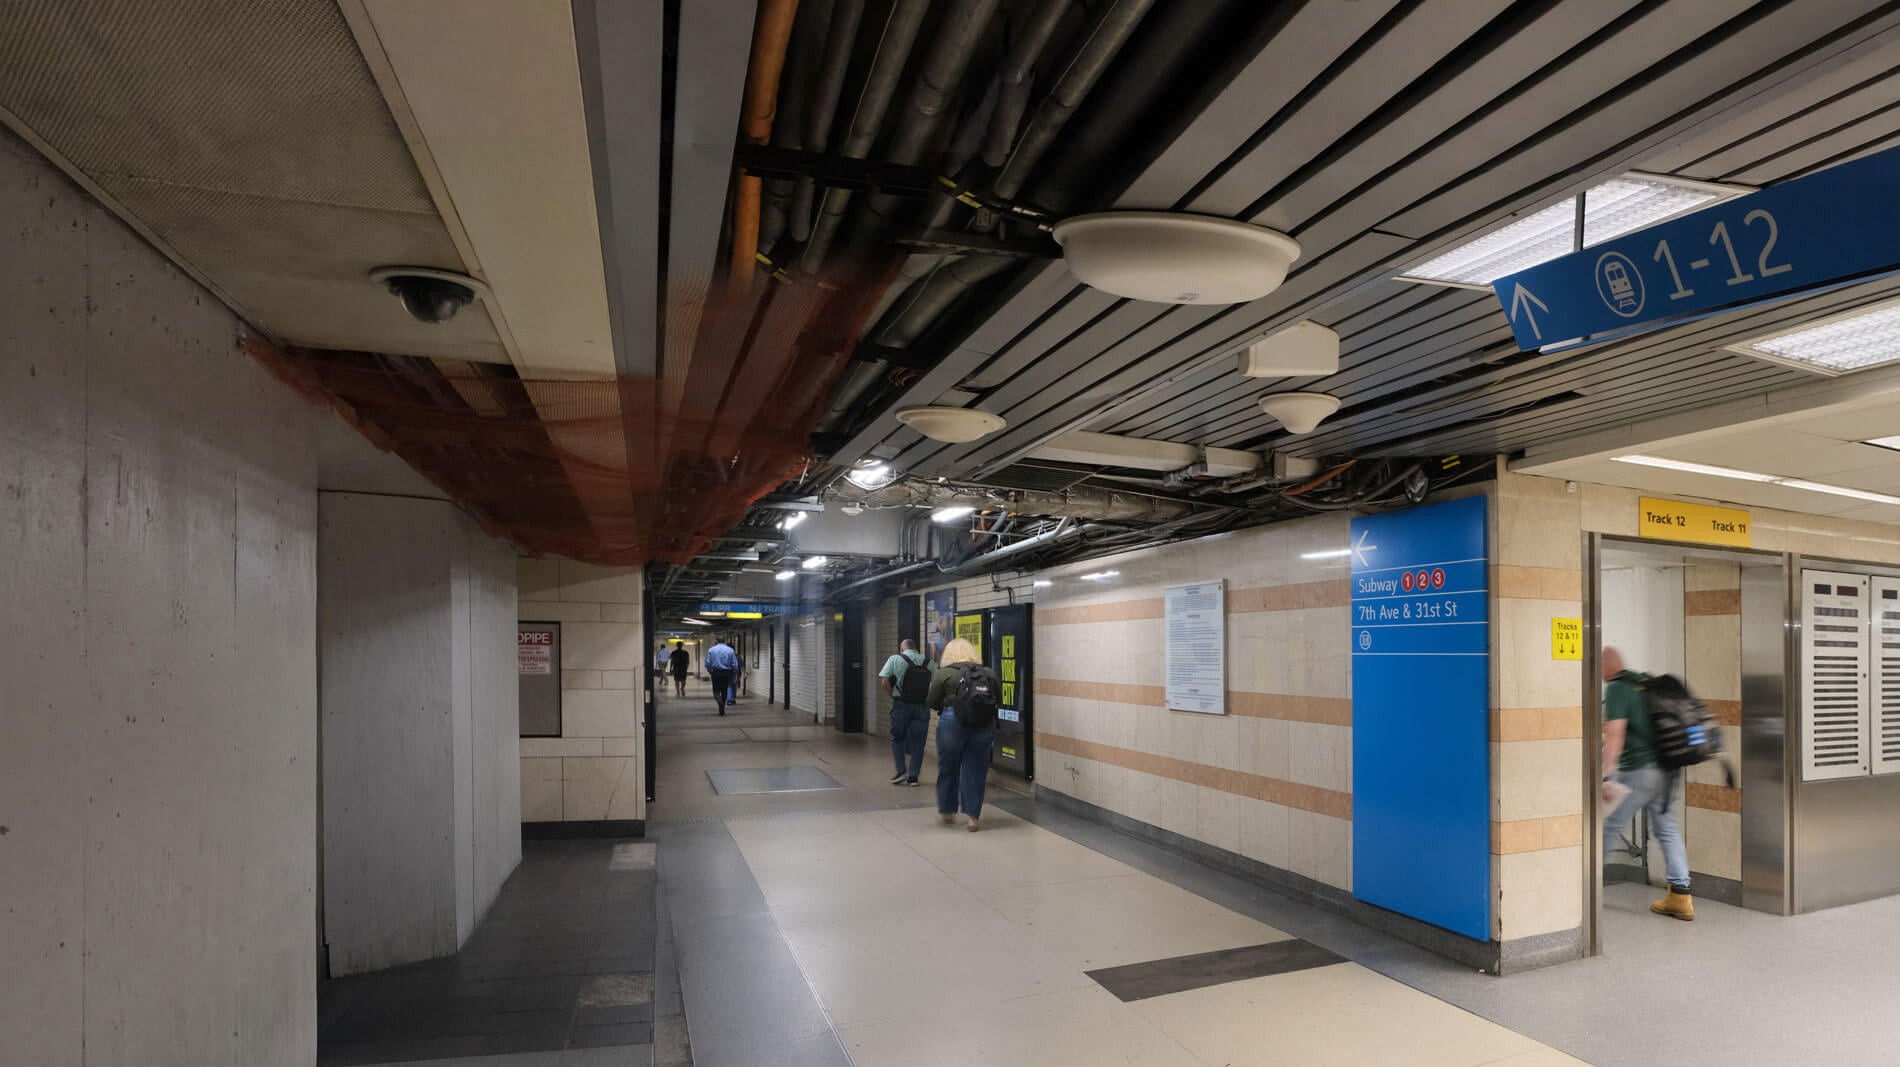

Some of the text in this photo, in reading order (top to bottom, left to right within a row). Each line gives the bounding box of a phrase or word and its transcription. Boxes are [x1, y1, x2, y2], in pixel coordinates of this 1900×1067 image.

[1653, 209, 1792, 301] 1-12
[1646, 511, 1686, 527] Track 12
[1712, 520, 1746, 534] Track 11
[1359, 578, 1398, 596] Subway
[1359, 600, 1457, 621] 7th Ave & 31st St
[1556, 632, 1564, 640] 12
[1557, 622, 1578, 631] Tracks
[1002, 635, 1015, 658] NEW
[1001, 659, 1016, 682] YORK
[1002, 682, 1015, 706] CITY
